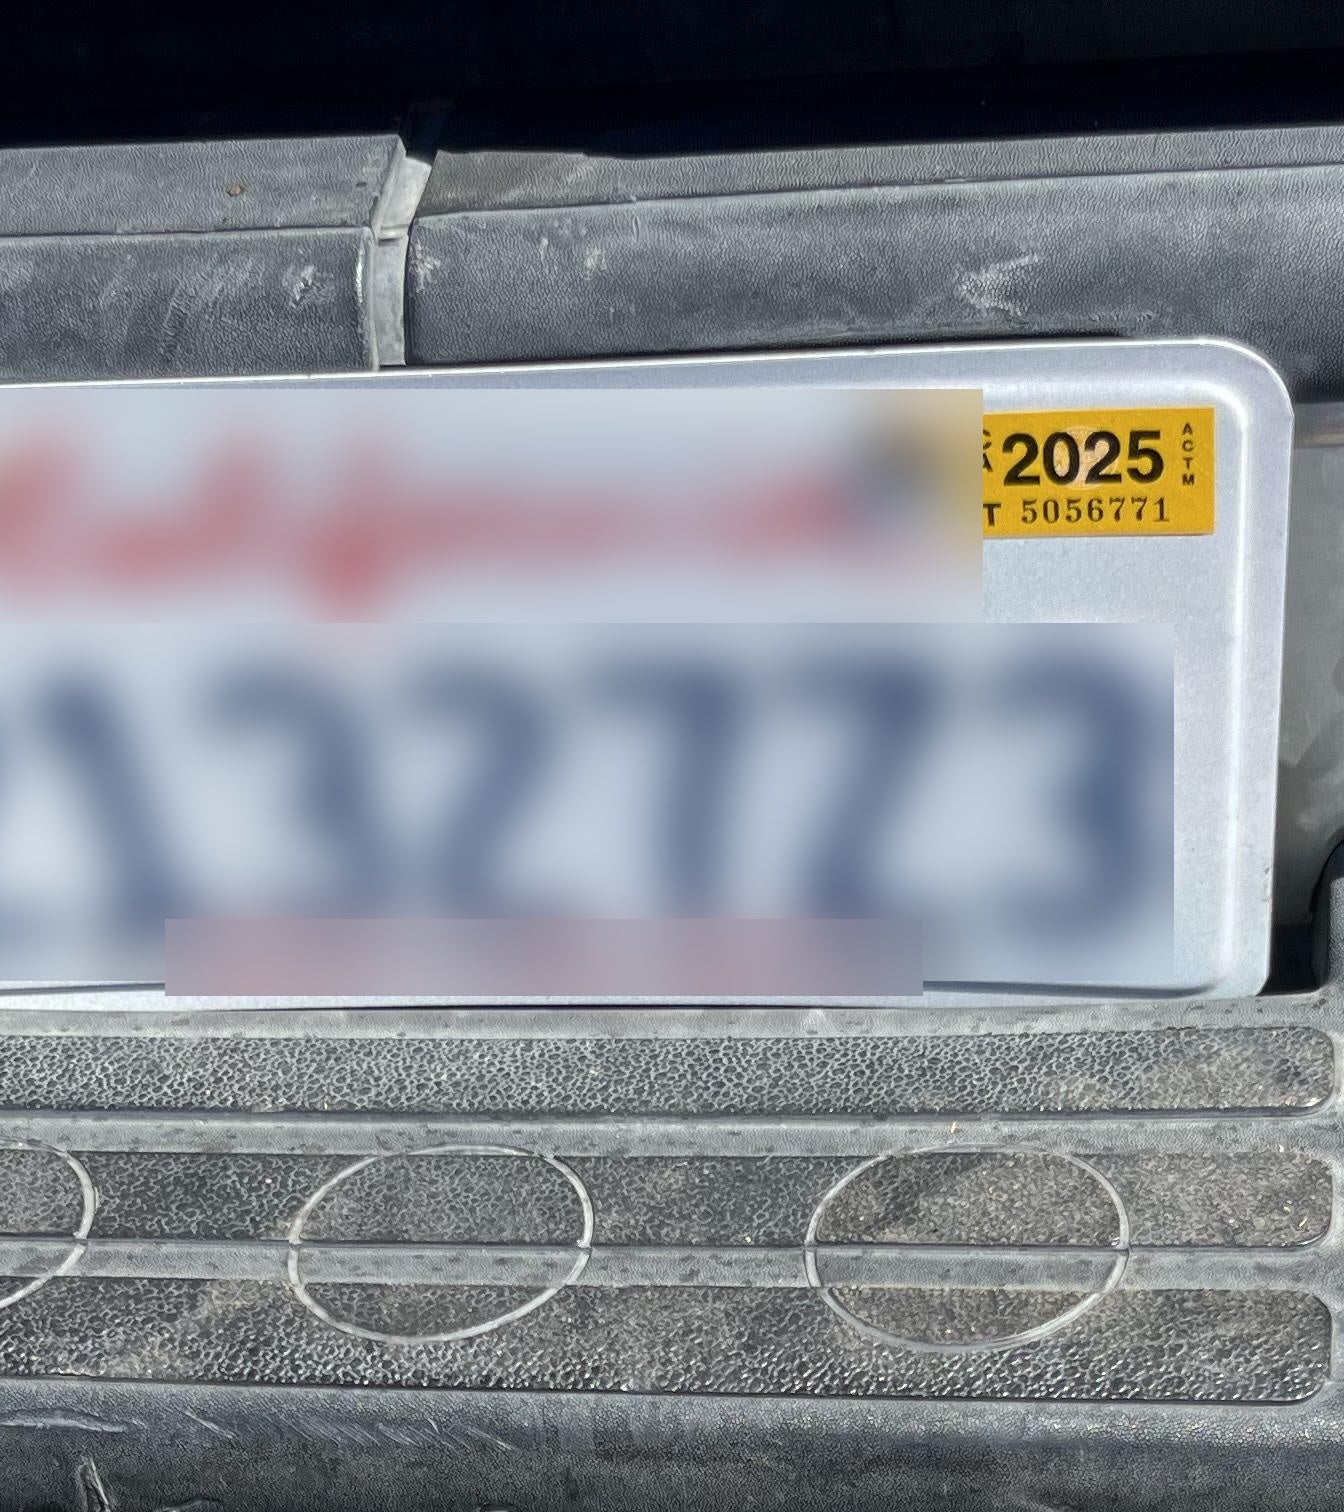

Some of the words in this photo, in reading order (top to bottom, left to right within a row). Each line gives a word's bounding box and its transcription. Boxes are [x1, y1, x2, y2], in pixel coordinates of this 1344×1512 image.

[1002, 430, 1164, 486] 2025
[1181, 422, 1196, 486] ACTM
[1020, 496, 1170, 524] 5056771
